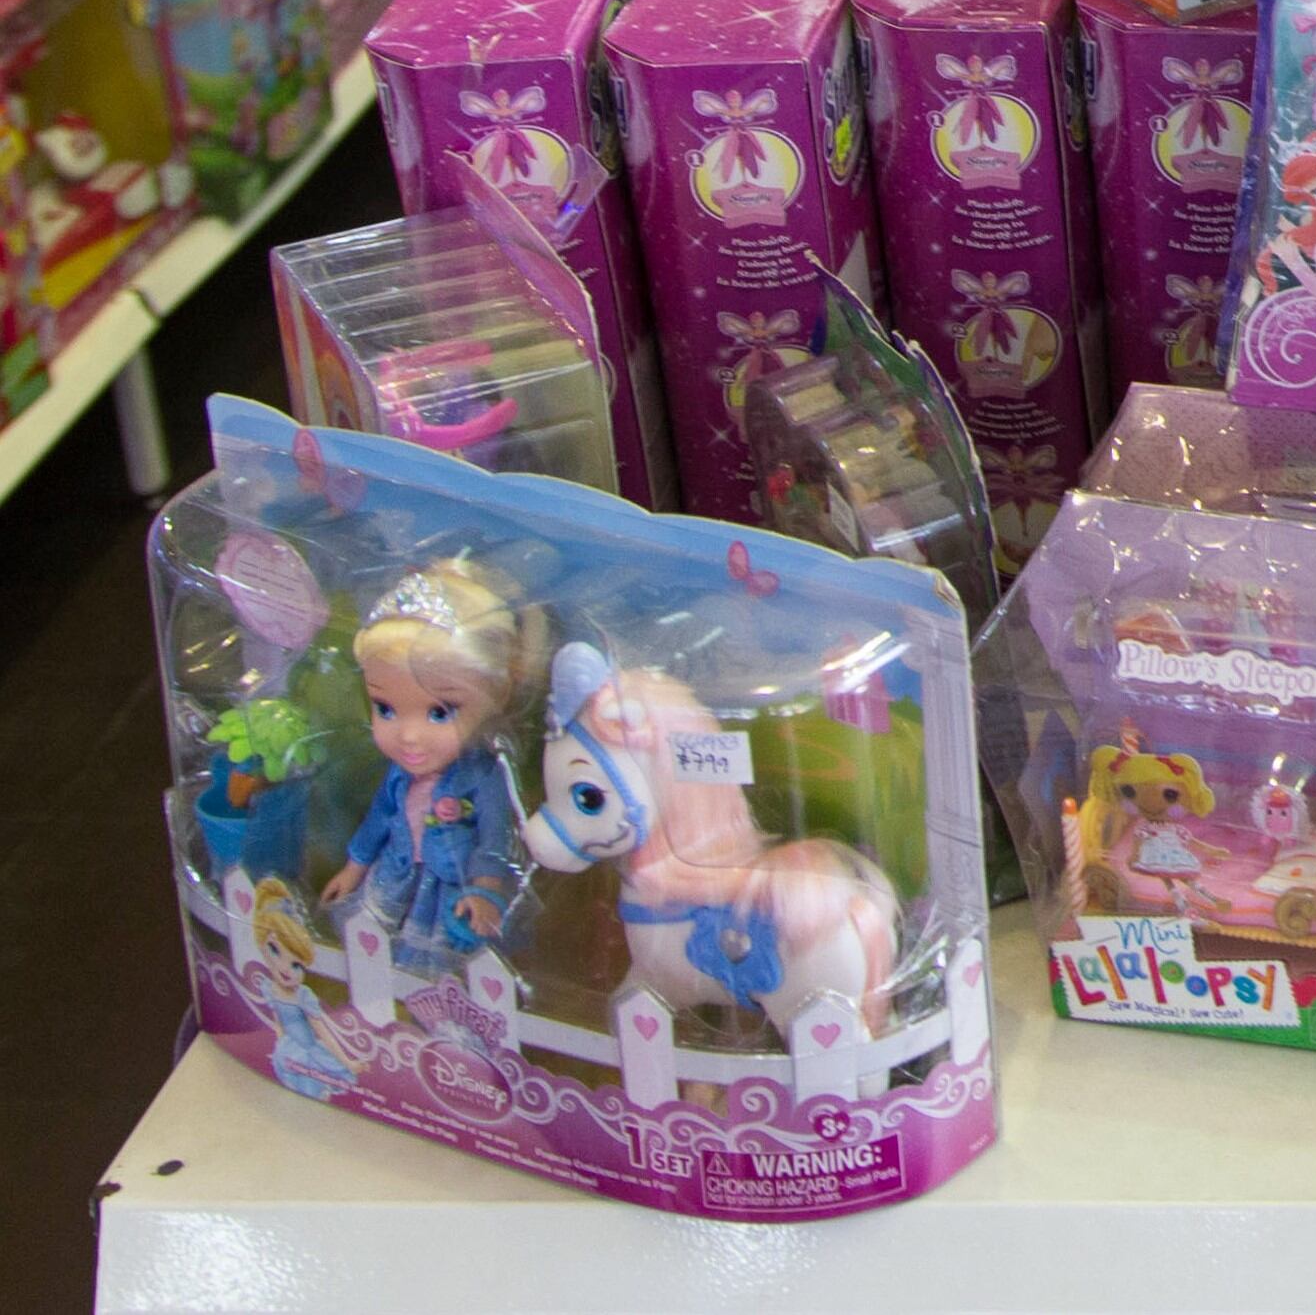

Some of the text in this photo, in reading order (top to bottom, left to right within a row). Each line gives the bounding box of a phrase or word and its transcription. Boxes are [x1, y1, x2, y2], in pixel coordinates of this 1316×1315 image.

[1121, 644, 1218, 682] Pillow's
[1116, 918, 1187, 954] Mini
[422, 1047, 508, 1111] Disney
[624, 1124, 646, 1169] 1
[651, 1152, 694, 1177] SET
[752, 1145, 883, 1179] WARNING:
[706, 1177, 773, 1197] CHOKING
[776, 1176, 839, 1196] HAZARD
